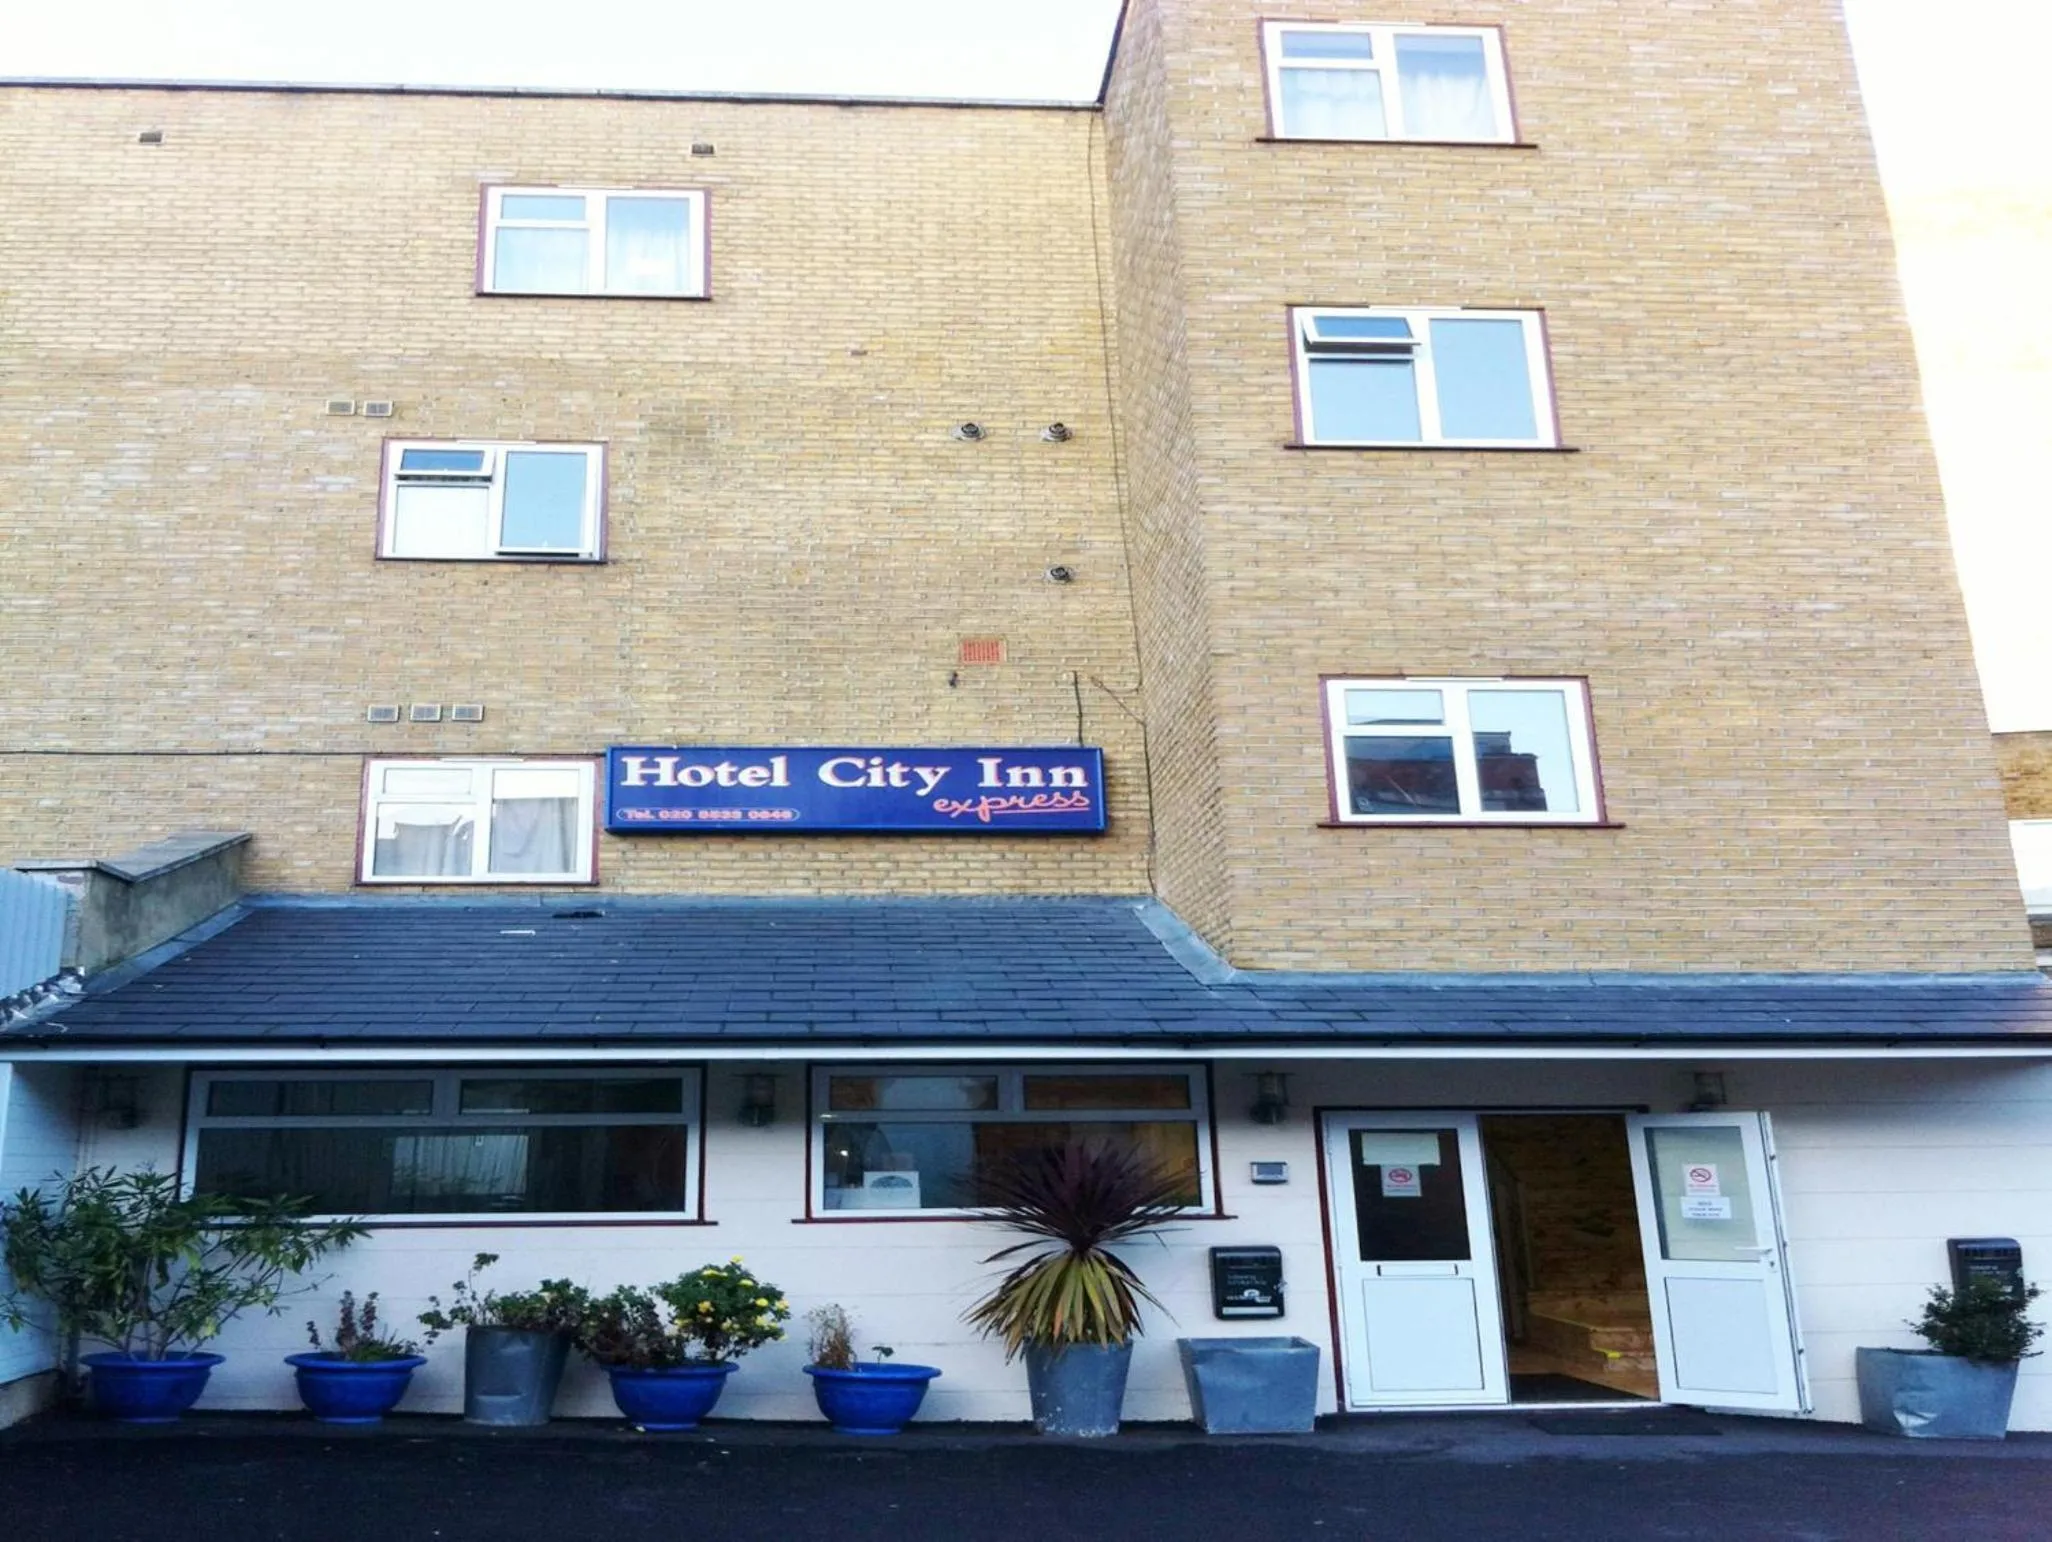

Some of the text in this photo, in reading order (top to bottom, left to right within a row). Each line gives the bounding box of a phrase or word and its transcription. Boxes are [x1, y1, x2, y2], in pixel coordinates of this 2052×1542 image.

[620, 755, 1089, 796] Hotel City Inn
[932, 790, 1090, 823] express
